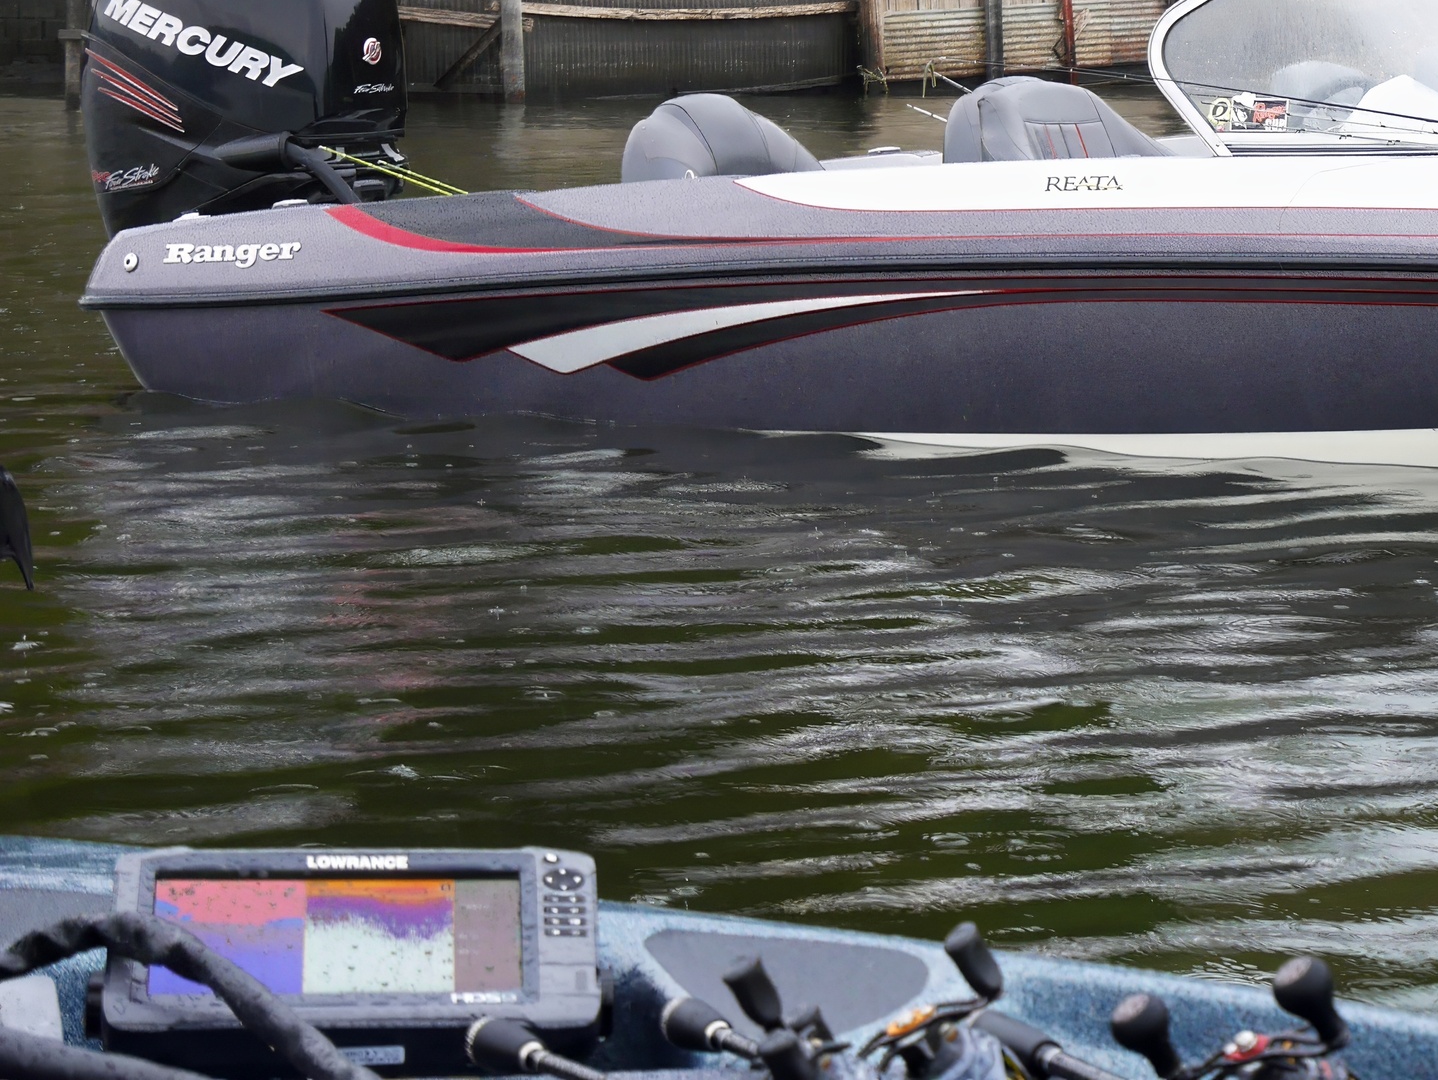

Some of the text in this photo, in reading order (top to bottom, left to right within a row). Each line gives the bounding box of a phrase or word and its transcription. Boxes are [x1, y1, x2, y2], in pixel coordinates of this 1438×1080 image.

[1044, 175, 1124, 192] REATA
[162, 241, 302, 269] Ranger
[306, 855, 409, 870] LOWRANCE
